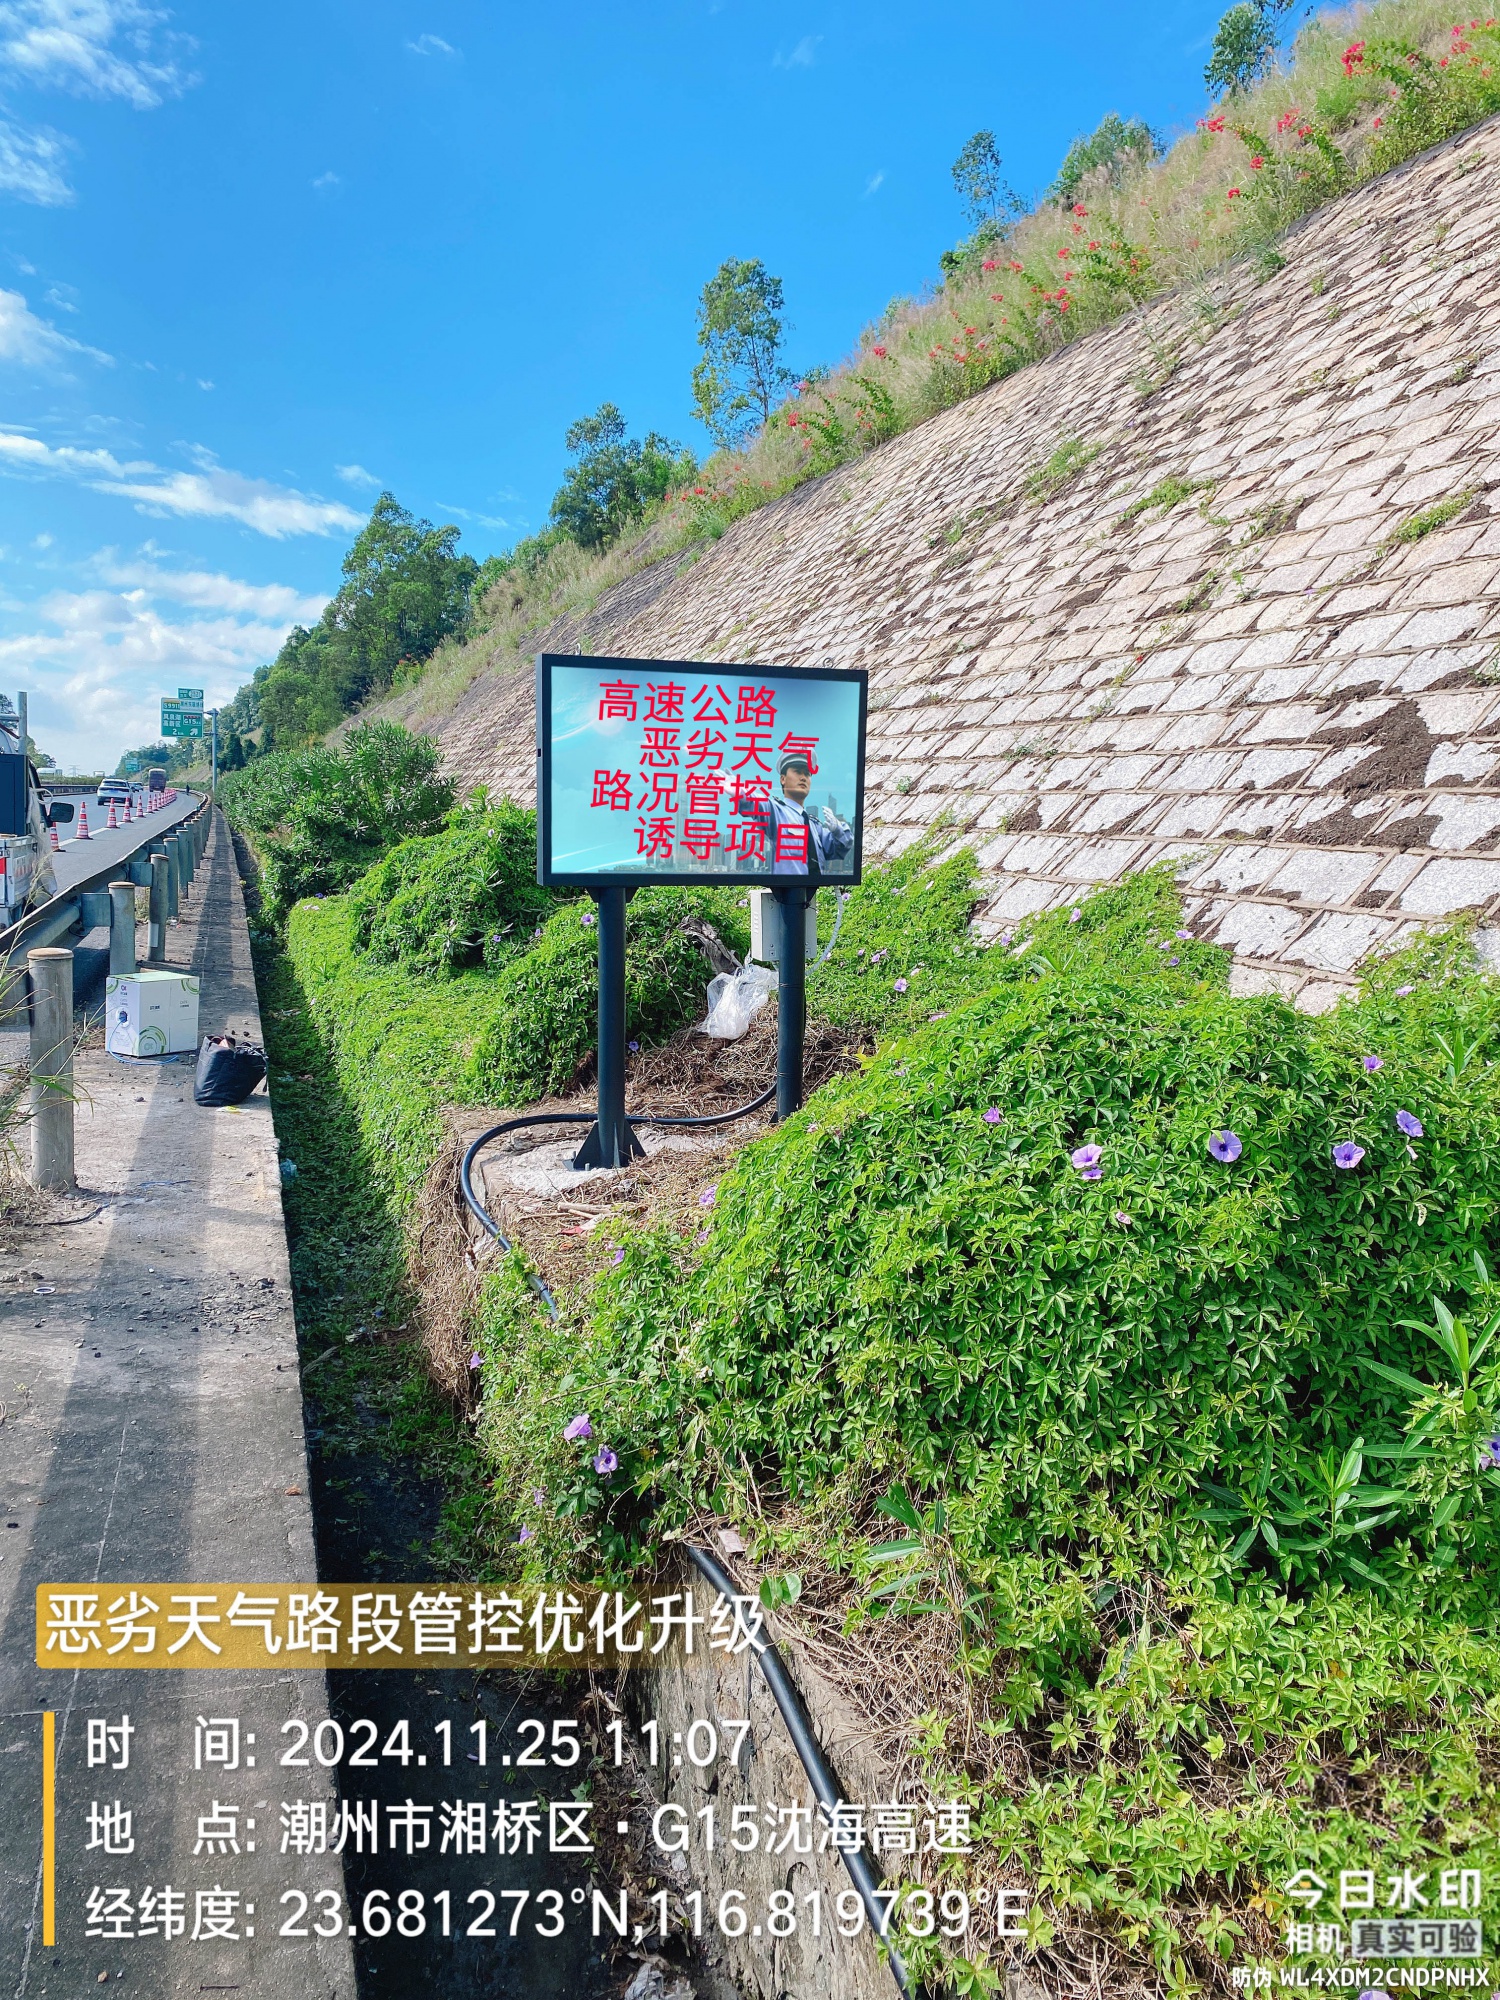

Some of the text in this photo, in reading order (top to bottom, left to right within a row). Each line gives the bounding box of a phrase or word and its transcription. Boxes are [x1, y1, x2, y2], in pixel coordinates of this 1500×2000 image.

[598, 680, 778, 728] 高速公路
[639, 727, 820, 775] 恶劣天气
[590, 769, 772, 817] 路况管控
[634, 816, 809, 864] 诱导项目
